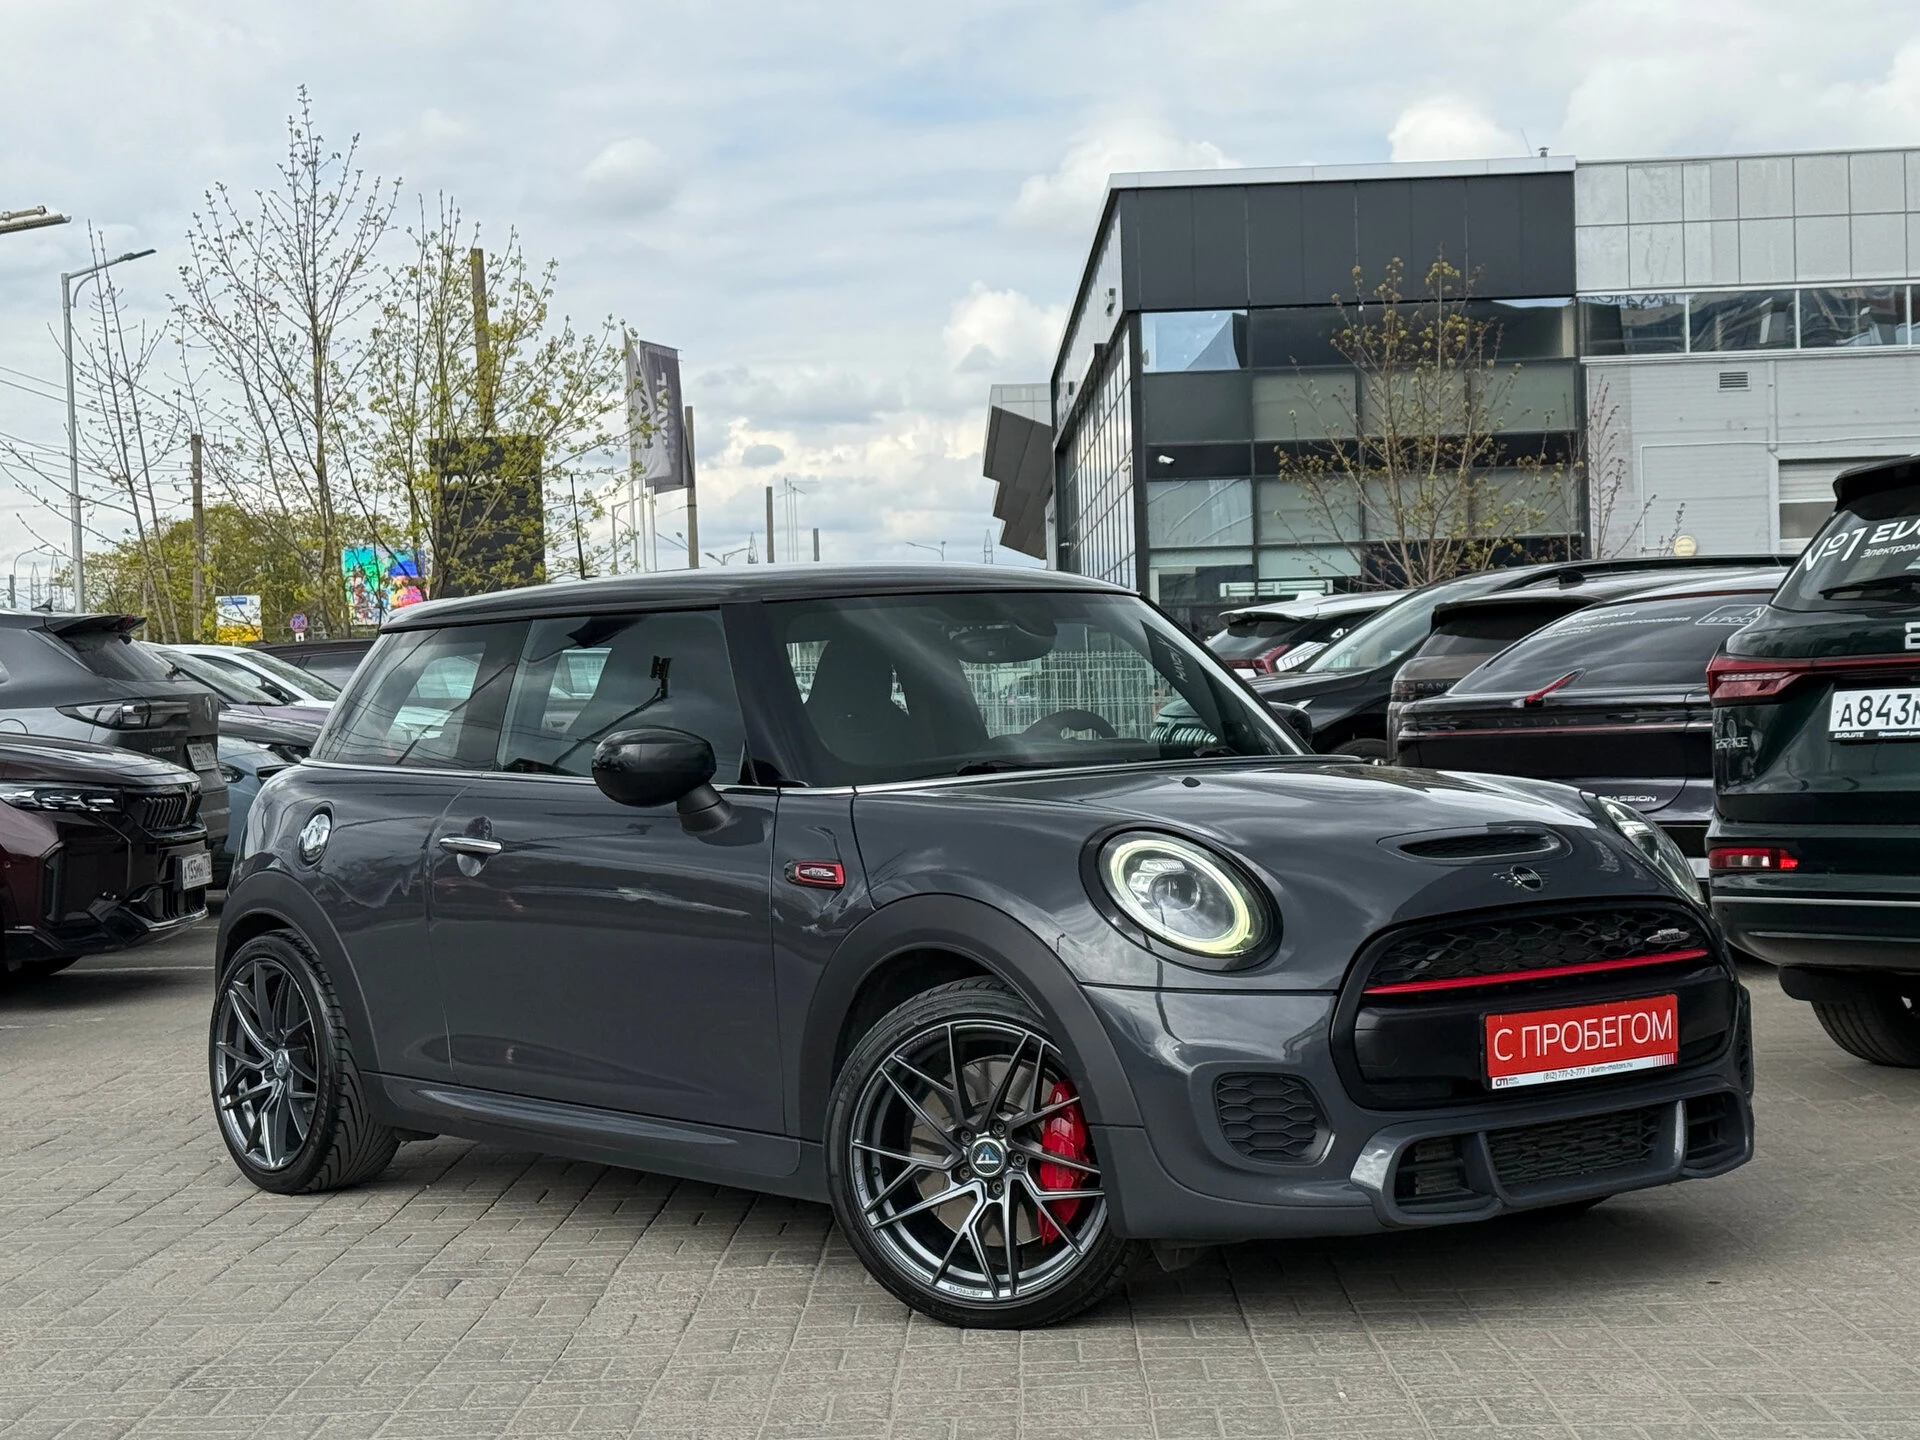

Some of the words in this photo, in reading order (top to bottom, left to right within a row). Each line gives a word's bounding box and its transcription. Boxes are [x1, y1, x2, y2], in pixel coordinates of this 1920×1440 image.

[1868, 518, 1920, 544] EV
[1494, 1029, 1513, 1061] С
[1522, 1009, 1672, 1058] ПРОБЕГОМ
